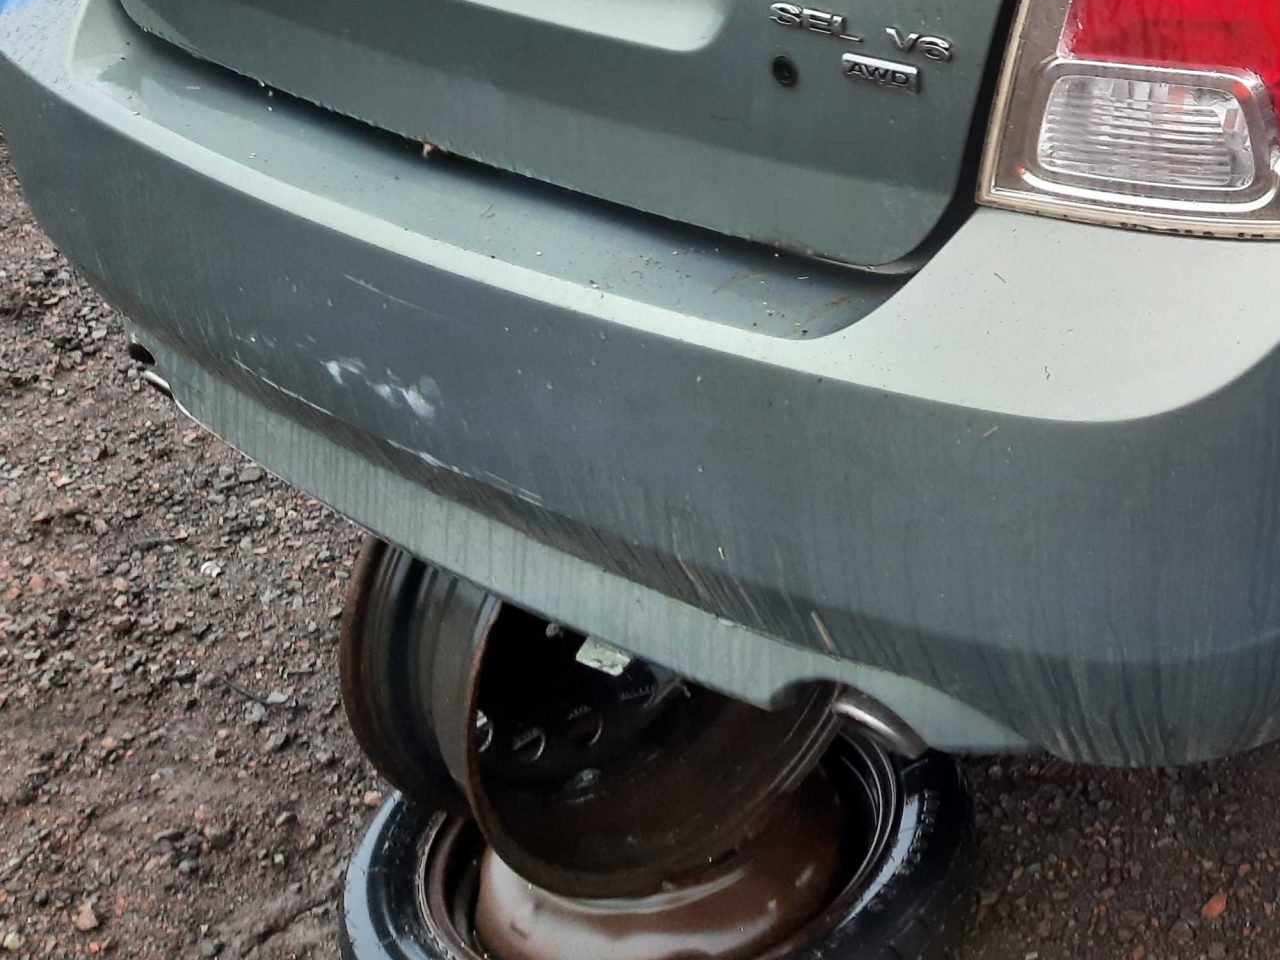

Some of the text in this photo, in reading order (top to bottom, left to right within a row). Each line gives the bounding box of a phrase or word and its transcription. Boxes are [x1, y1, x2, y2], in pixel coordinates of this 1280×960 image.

[769, 2, 954, 61] SEL V6
[846, 59, 913, 89] AWD
